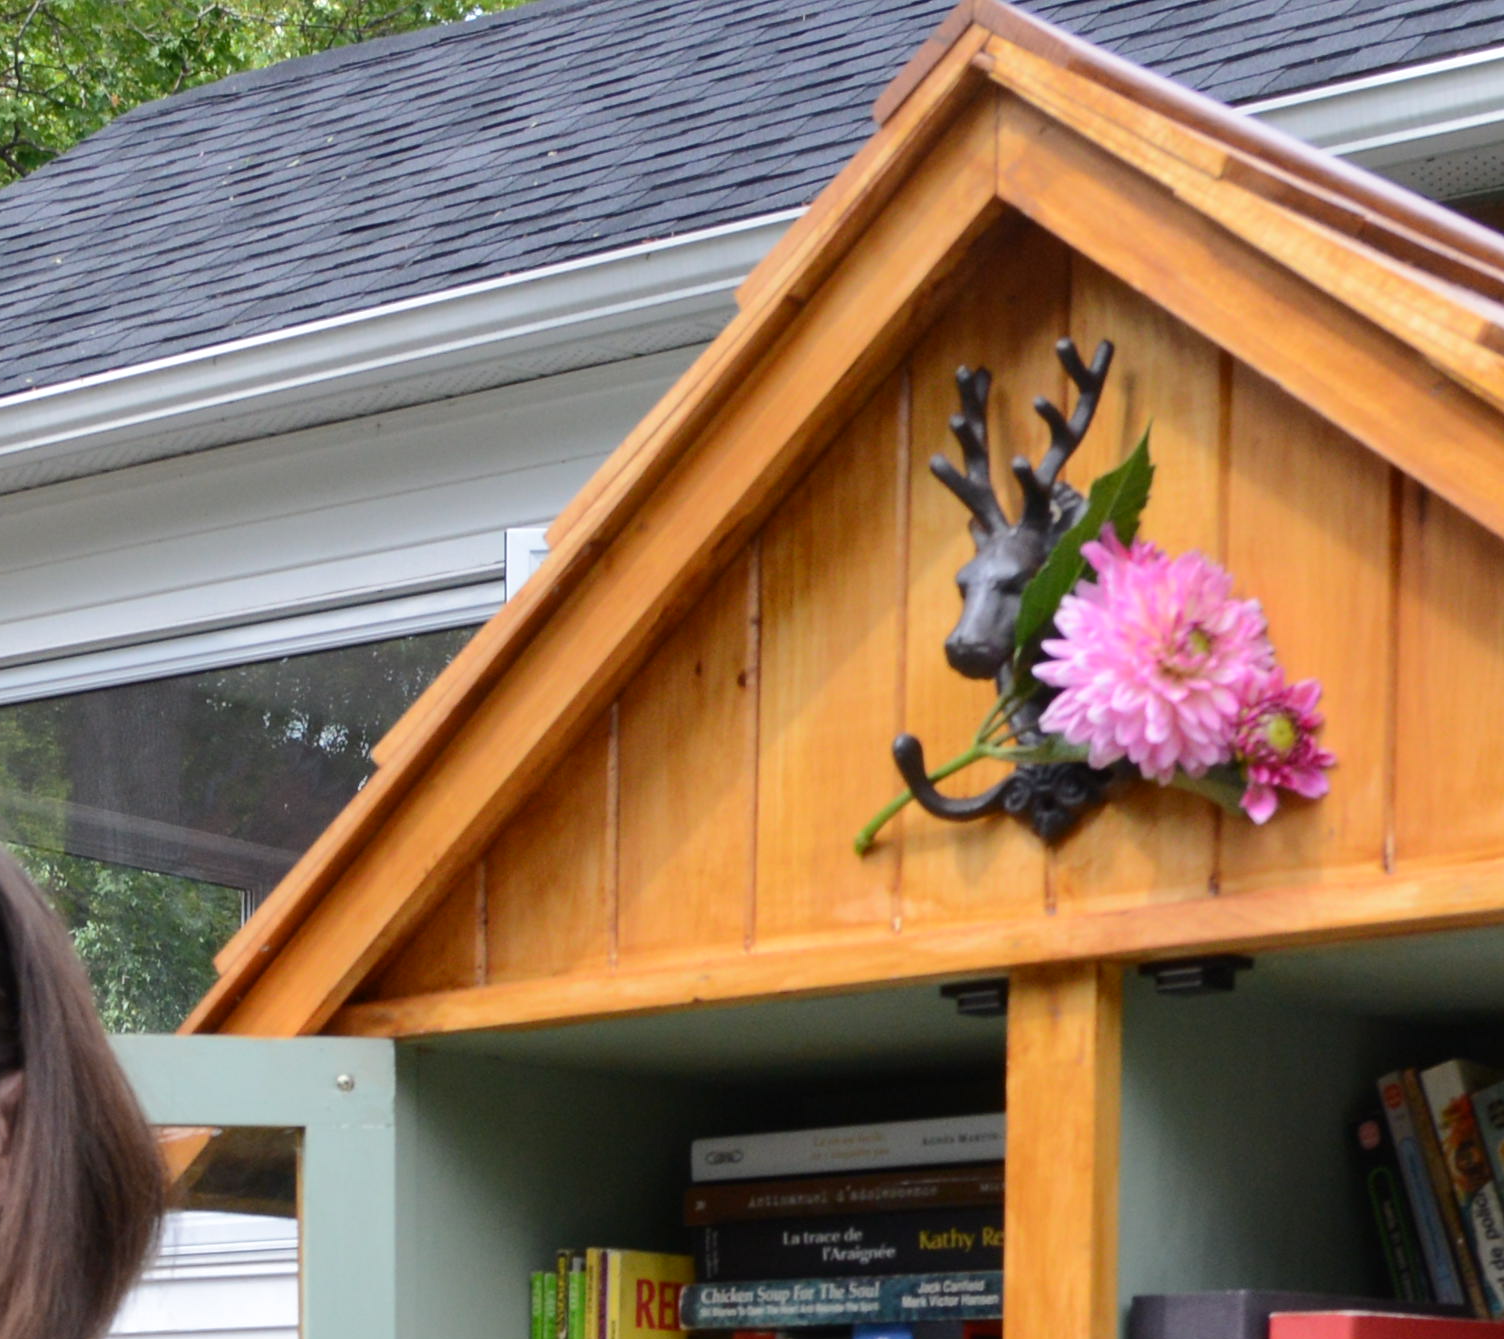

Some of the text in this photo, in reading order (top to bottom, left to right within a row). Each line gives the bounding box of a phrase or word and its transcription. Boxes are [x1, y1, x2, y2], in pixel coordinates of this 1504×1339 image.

[783, 1226, 863, 1245] La trace de
[919, 1227, 976, 1253] Kathy
[822, 1245, 896, 1264] l'Araignée
[700, 1281, 881, 1307] Chicken Soup For The Soul
[918, 1279, 986, 1295] Jack Canfield
[901, 1293, 999, 1309] Mark Victor Hansen
